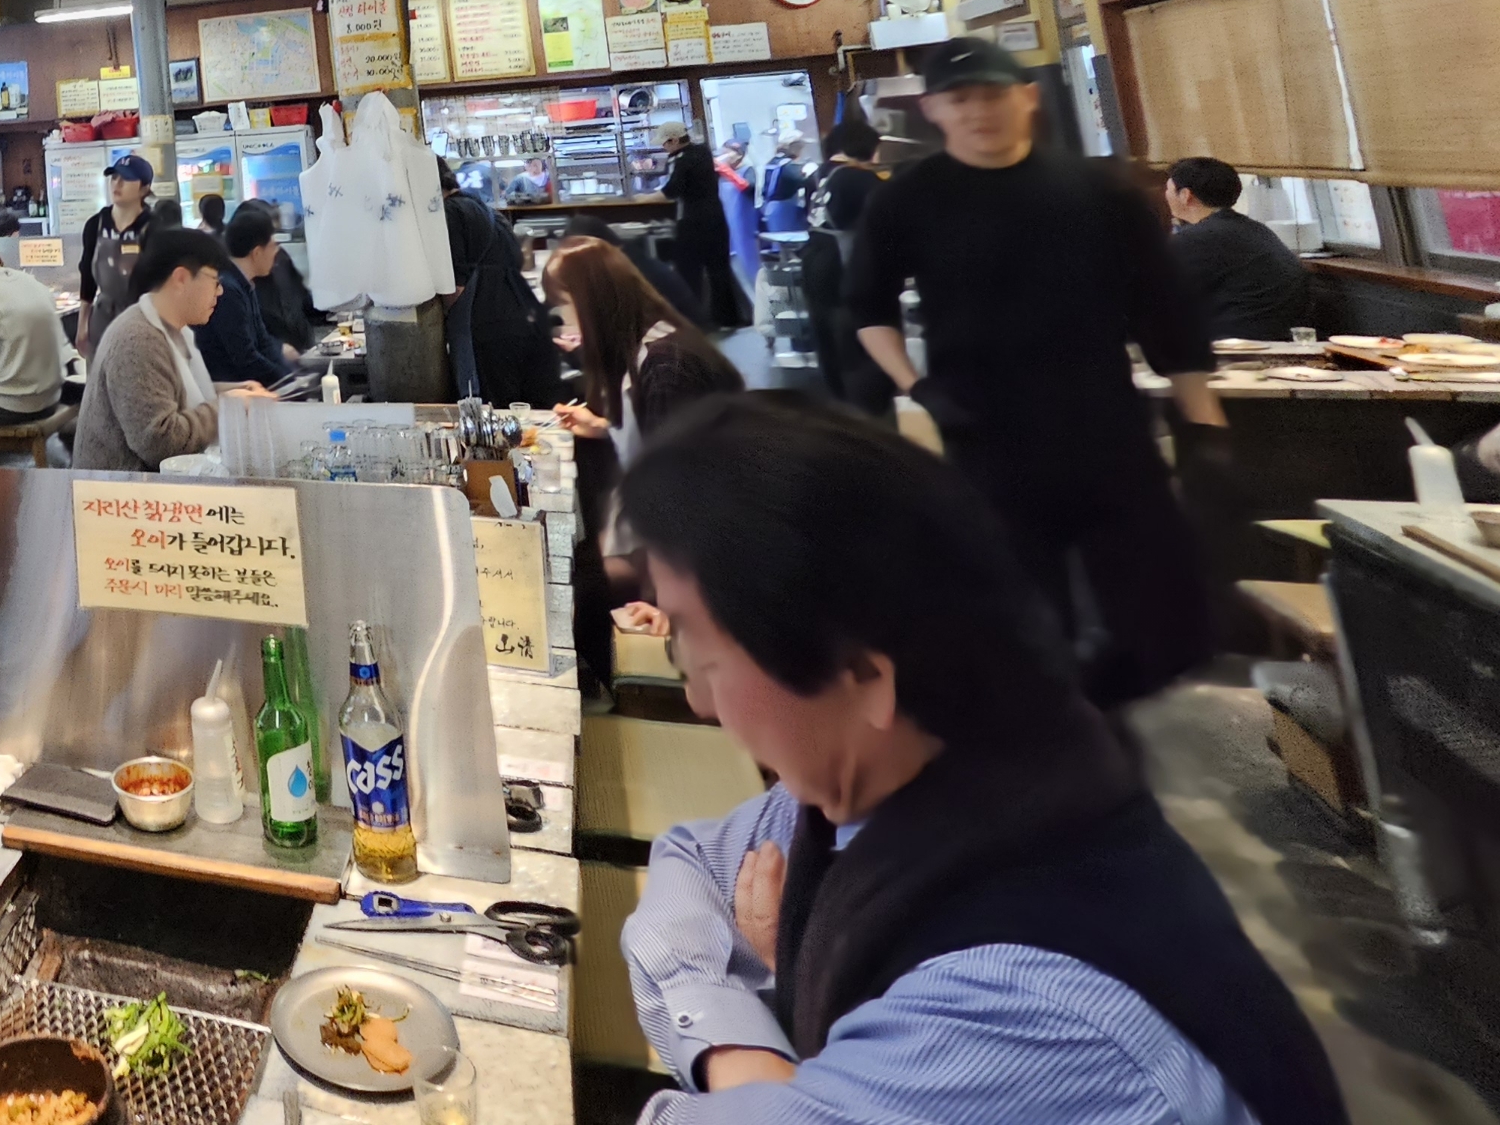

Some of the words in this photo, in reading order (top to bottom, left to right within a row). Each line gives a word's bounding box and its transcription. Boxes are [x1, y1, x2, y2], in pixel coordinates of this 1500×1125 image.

[82, 498, 140, 520] 지리산
[130, 528, 186, 551] 오이가
[190, 531, 296, 560] 들어갑니다.
[104, 557, 143, 576] 오이를
[148, 562, 185, 580] 드시지
[188, 565, 232, 583] 못하는
[234, 568, 278, 587] 분들은
[104, 578, 149, 596] 주문시
[154, 583, 183, 600] 미리
[185, 585, 279, 608] 말씀해주세요.
